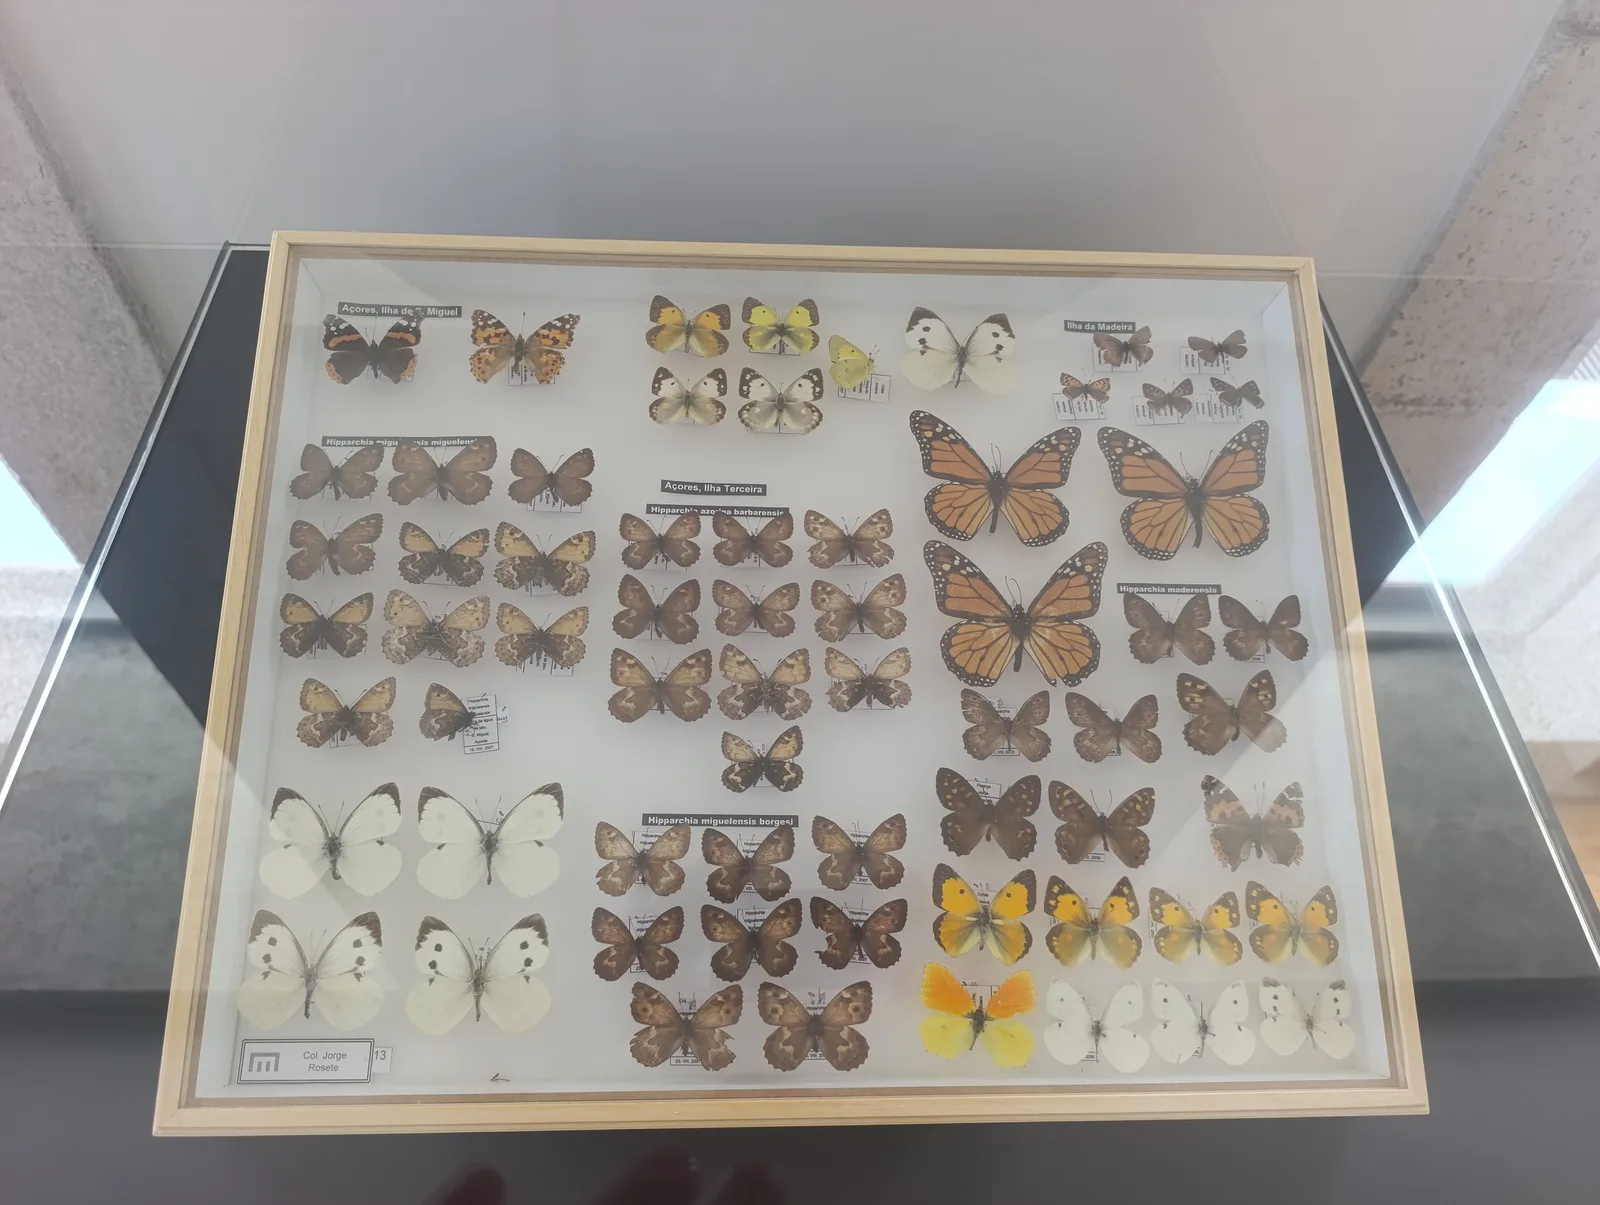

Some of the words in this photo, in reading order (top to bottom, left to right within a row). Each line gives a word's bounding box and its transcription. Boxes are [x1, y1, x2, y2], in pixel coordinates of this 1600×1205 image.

[341, 304, 379, 315] Açores,
[381, 305, 399, 315] Ilha
[401, 306, 413, 316] de
[427, 307, 459, 318] Miguel
[1067, 321, 1083, 330] Ilha
[1084, 322, 1096, 331] da
[1097, 323, 1133, 331] Madeira
[326, 438, 374, 447] Hipparchia
[664, 481, 701, 493] Açores,
[704, 483, 721, 492] Ilha
[724, 484, 763, 494] Terceira
[1119, 585, 1166, 595] Hipparchia
[1167, 586, 1217, 594] maderensis
[648, 816, 699, 826] Hipparchia
[701, 817, 757, 827] miguelensis
[759, 818, 794, 827] borgesi
[303, 1051, 320, 1060] Col.
[322, 1051, 347, 1062] Jorge
[374, 1050, 387, 1061] 13
[308, 1063, 339, 1072] Rosete
